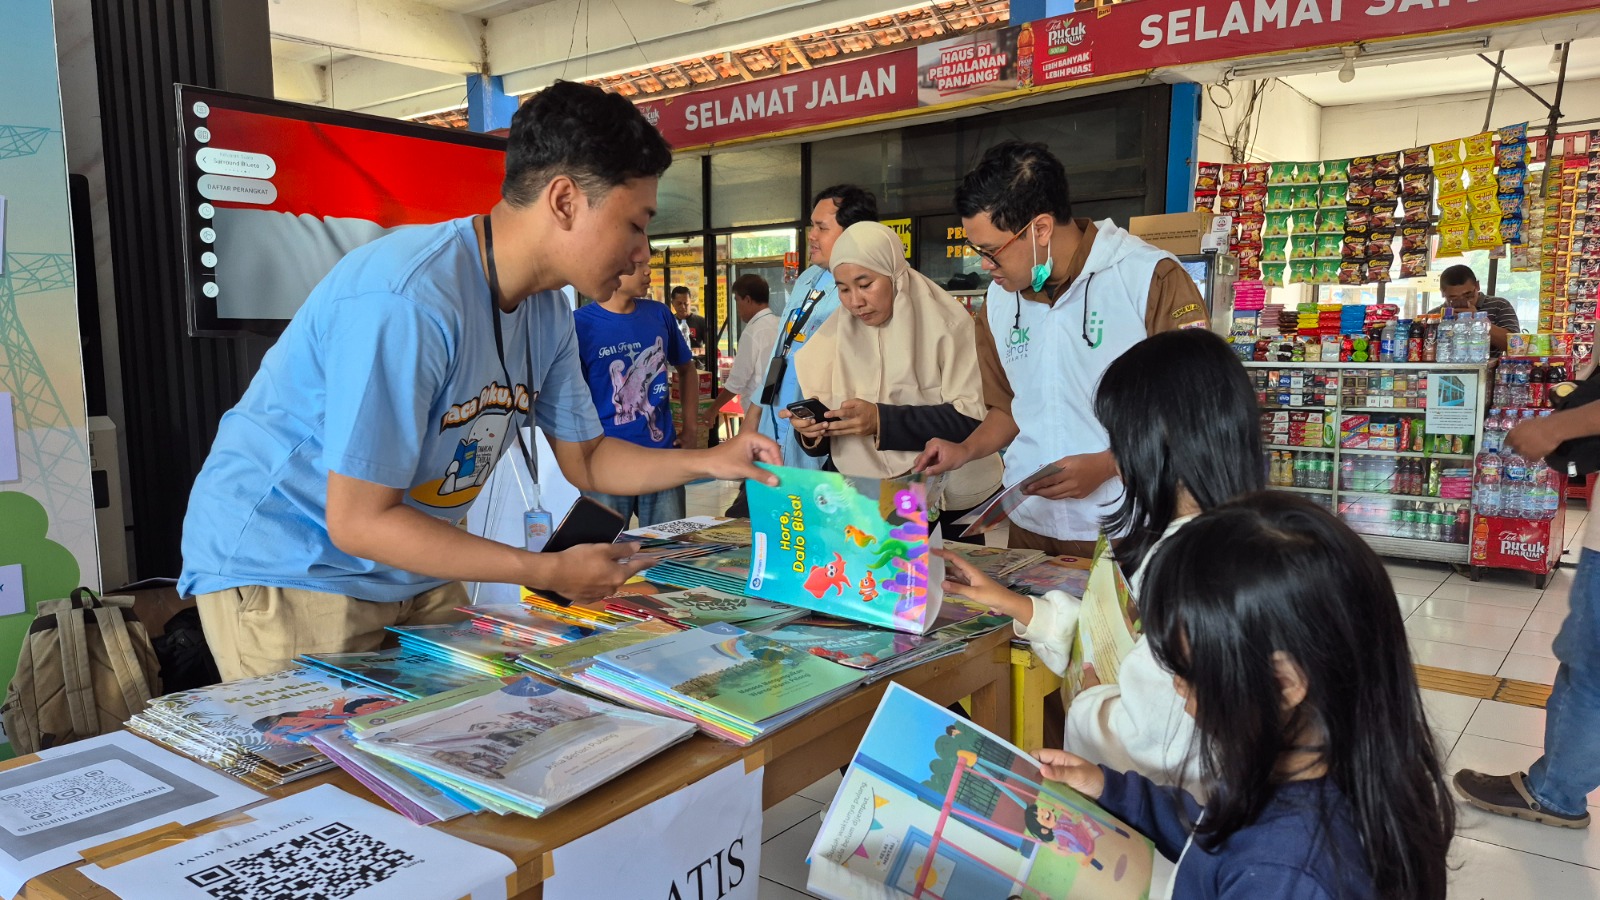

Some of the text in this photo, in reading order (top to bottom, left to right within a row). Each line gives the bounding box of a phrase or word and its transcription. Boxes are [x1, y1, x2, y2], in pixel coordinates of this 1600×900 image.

[942, 44, 991, 65] HAUS DI
[1042, 51, 1090, 72] LEBIH BANYAK
[929, 54, 1006, 80] PERJALANAN
[1045, 63, 1092, 79] LEBIH PUAS!
[938, 68, 999, 90] PANJANG?
[684, 65, 896, 131] SELAMAT JALAN
[207, 183, 269, 195] DAFTAR PERANGKAT
[780, 511, 791, 551] Hore,
[787, 494, 806, 573] Dalo Bisa!
[1507, 548, 1542, 559] HARUM
[223, 680, 324, 704] Ke Hutan
[244, 686, 330, 707] Lindung
[839, 804, 856, 836] waktunya
[174, 815, 315, 867] TANDA TERIMA BUKU
[843, 826, 855, 848] belum
